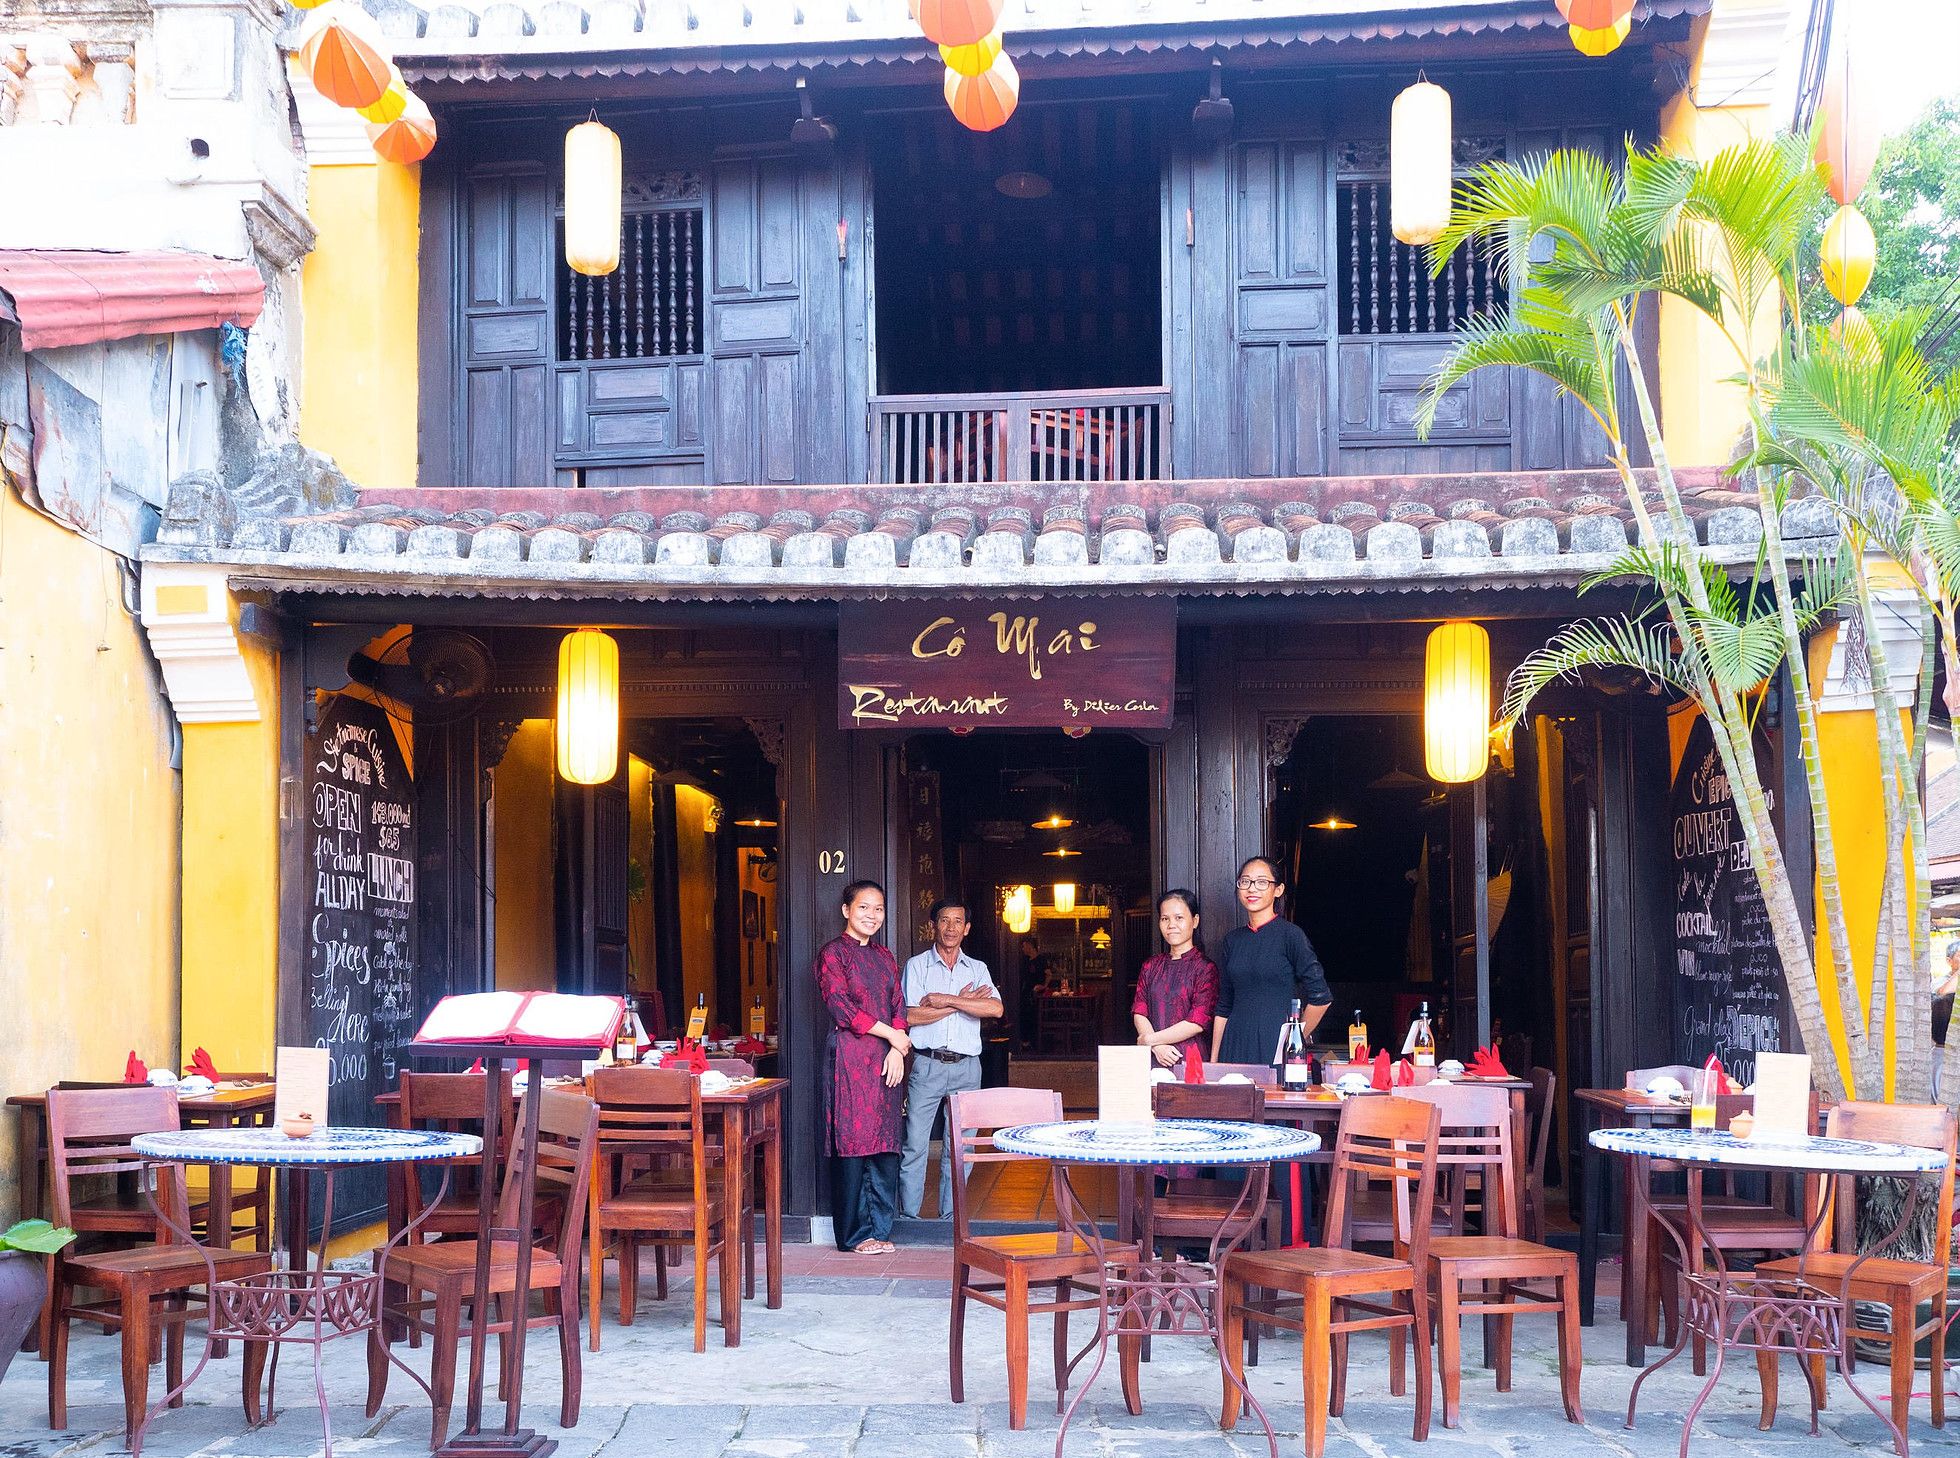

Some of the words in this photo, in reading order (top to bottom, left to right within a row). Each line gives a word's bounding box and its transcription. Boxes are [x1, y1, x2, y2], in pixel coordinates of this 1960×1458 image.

[911, 616, 967, 659] Cô
[988, 612, 1101, 680] Mai
[1063, 698, 1080, 717] By
[312, 781, 362, 834] OPEN
[312, 834, 338, 870] for
[333, 832, 365, 873] drink
[1674, 807, 1732, 860] OUVERT
[368, 852, 413, 902] LUNCH
[818, 850, 846, 874] 02
